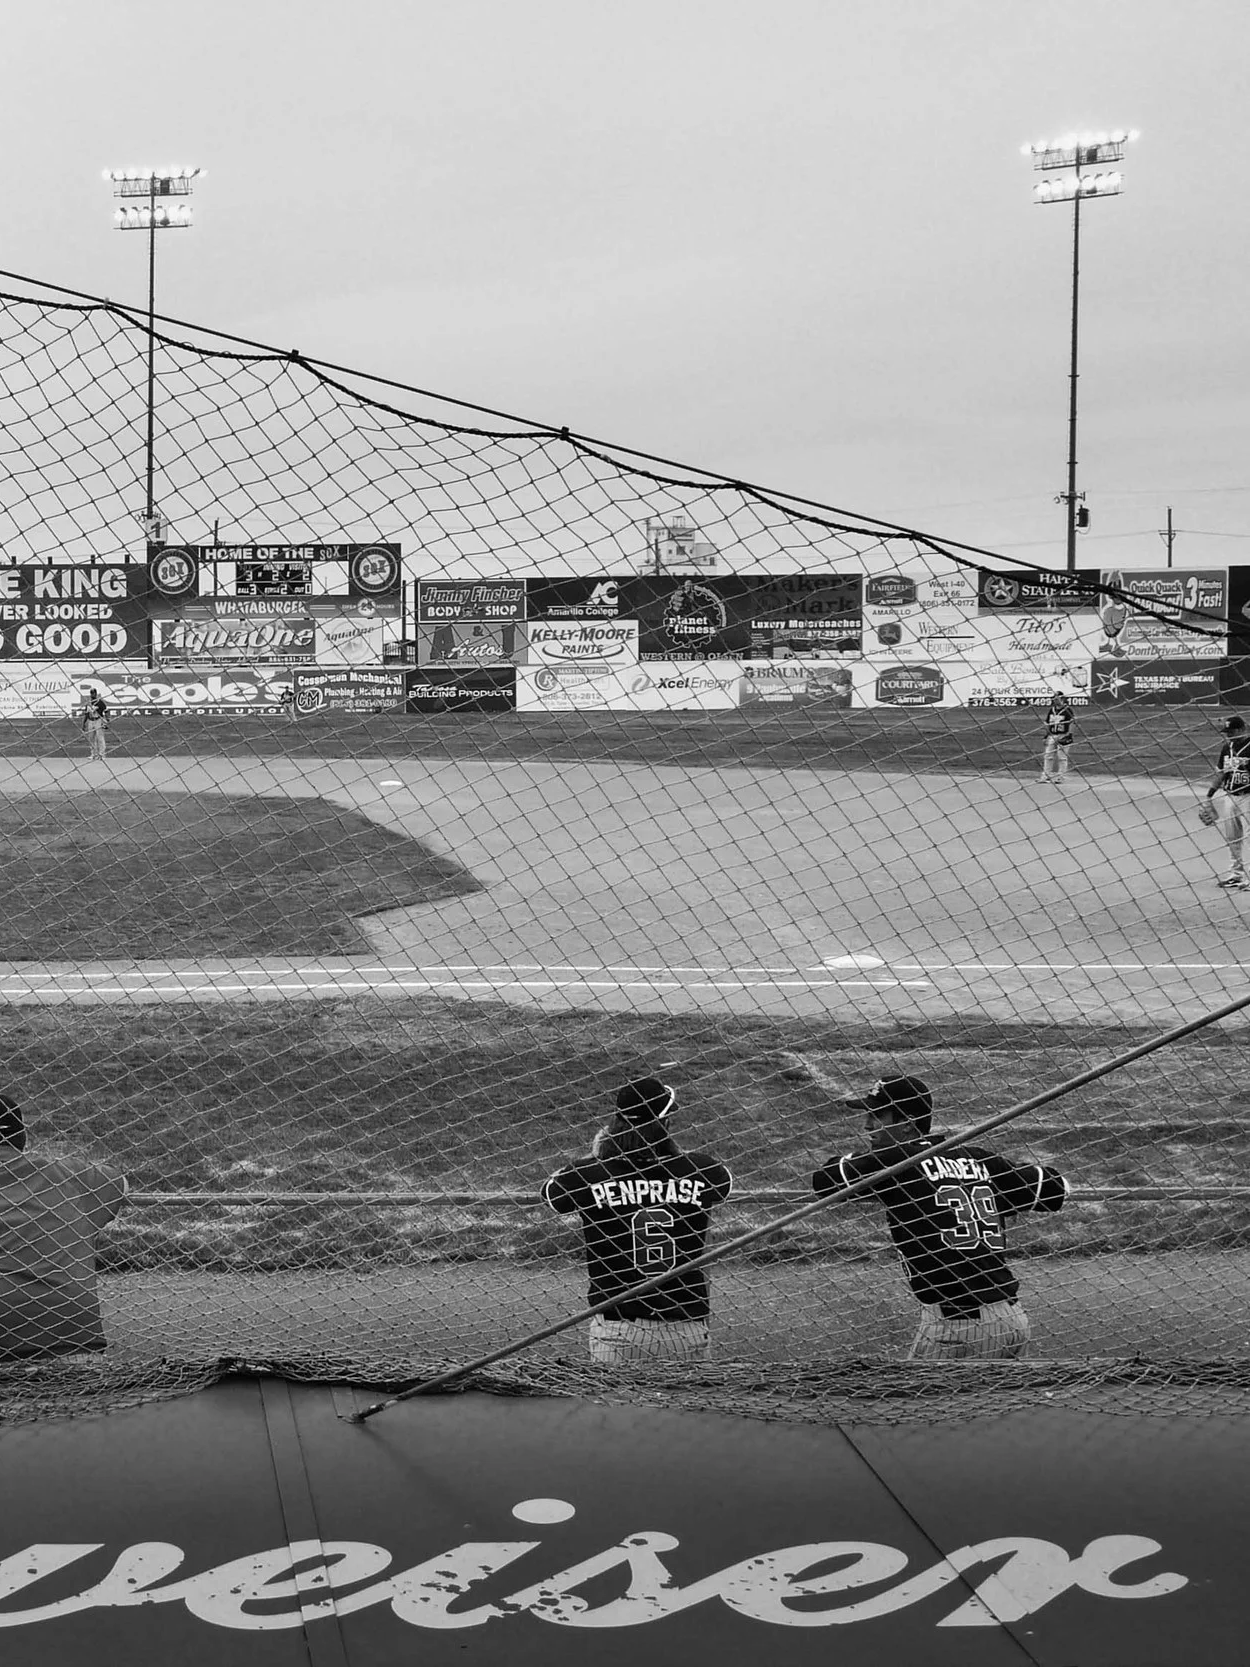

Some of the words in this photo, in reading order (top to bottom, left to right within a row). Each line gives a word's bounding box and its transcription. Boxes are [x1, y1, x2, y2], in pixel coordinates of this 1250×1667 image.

[205, 548, 253, 560] HOME
[256, 548, 278, 559] OF
[282, 547, 314, 559] THE
[319, 545, 341, 560] SOX
[272, 570, 279, 581] 2
[302, 570, 310, 581] 2
[34, 568, 128, 599] KING
[249, 583, 257, 595] 3
[280, 583, 287, 595] 2
[1131, 580, 1155, 594] Quick
[1155, 580, 1182, 595] Quack
[1184, 576, 1199, 610] 3
[1198, 590, 1223, 608] Fast!
[34, 603, 113, 620] LOOKED
[214, 600, 308, 615] WHATABURGER
[427, 606, 461, 617] BODY
[484, 605, 518, 616] SHOP
[585, 607, 619, 617] College
[751, 620, 786, 630] Luxury
[15, 623, 128, 654] GOOD
[162, 624, 315, 653] AquaOne
[530, 627, 636, 642] KELLY-MOORE
[561, 644, 605, 654] PAINTS
[640, 652, 693, 661] WESTERN
[121, 674, 151, 684] The
[657, 677, 689, 689] Xcel
[72, 670, 294, 706] People's
[458, 689, 514, 698] PRODUCTS
[1015, 686, 1053, 695] SERVICE
[1067, 697, 1089, 706] 10th
[161, 708, 224, 716] CREDIT
[590, 1178, 706, 1210] PENPRASE
[934, 1184, 1005, 1250] 39
[630, 1208, 676, 1275] 6
